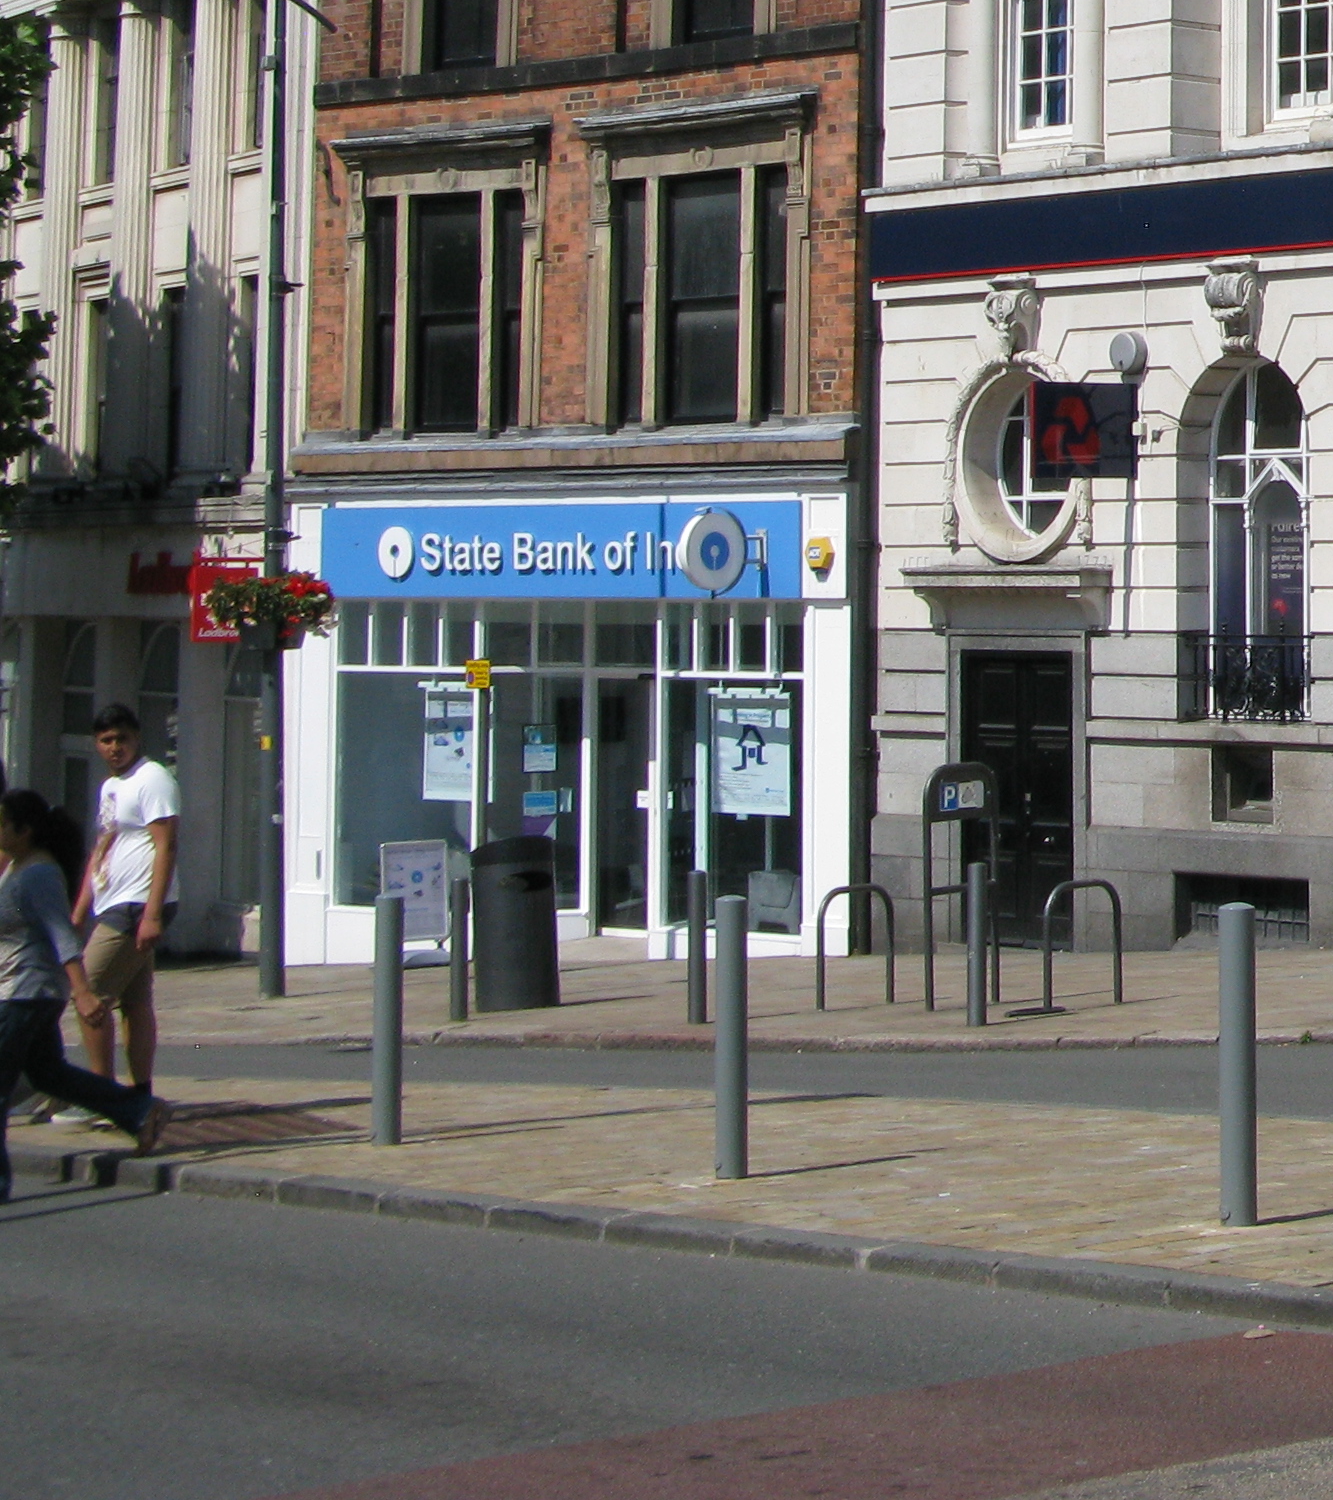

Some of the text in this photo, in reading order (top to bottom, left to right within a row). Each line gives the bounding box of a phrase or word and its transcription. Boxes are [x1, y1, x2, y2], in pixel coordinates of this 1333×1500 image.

[420, 532, 502, 572] State
[512, 531, 597, 571] Bank
[603, 531, 638, 571] of
[943, 785, 956, 809] P
